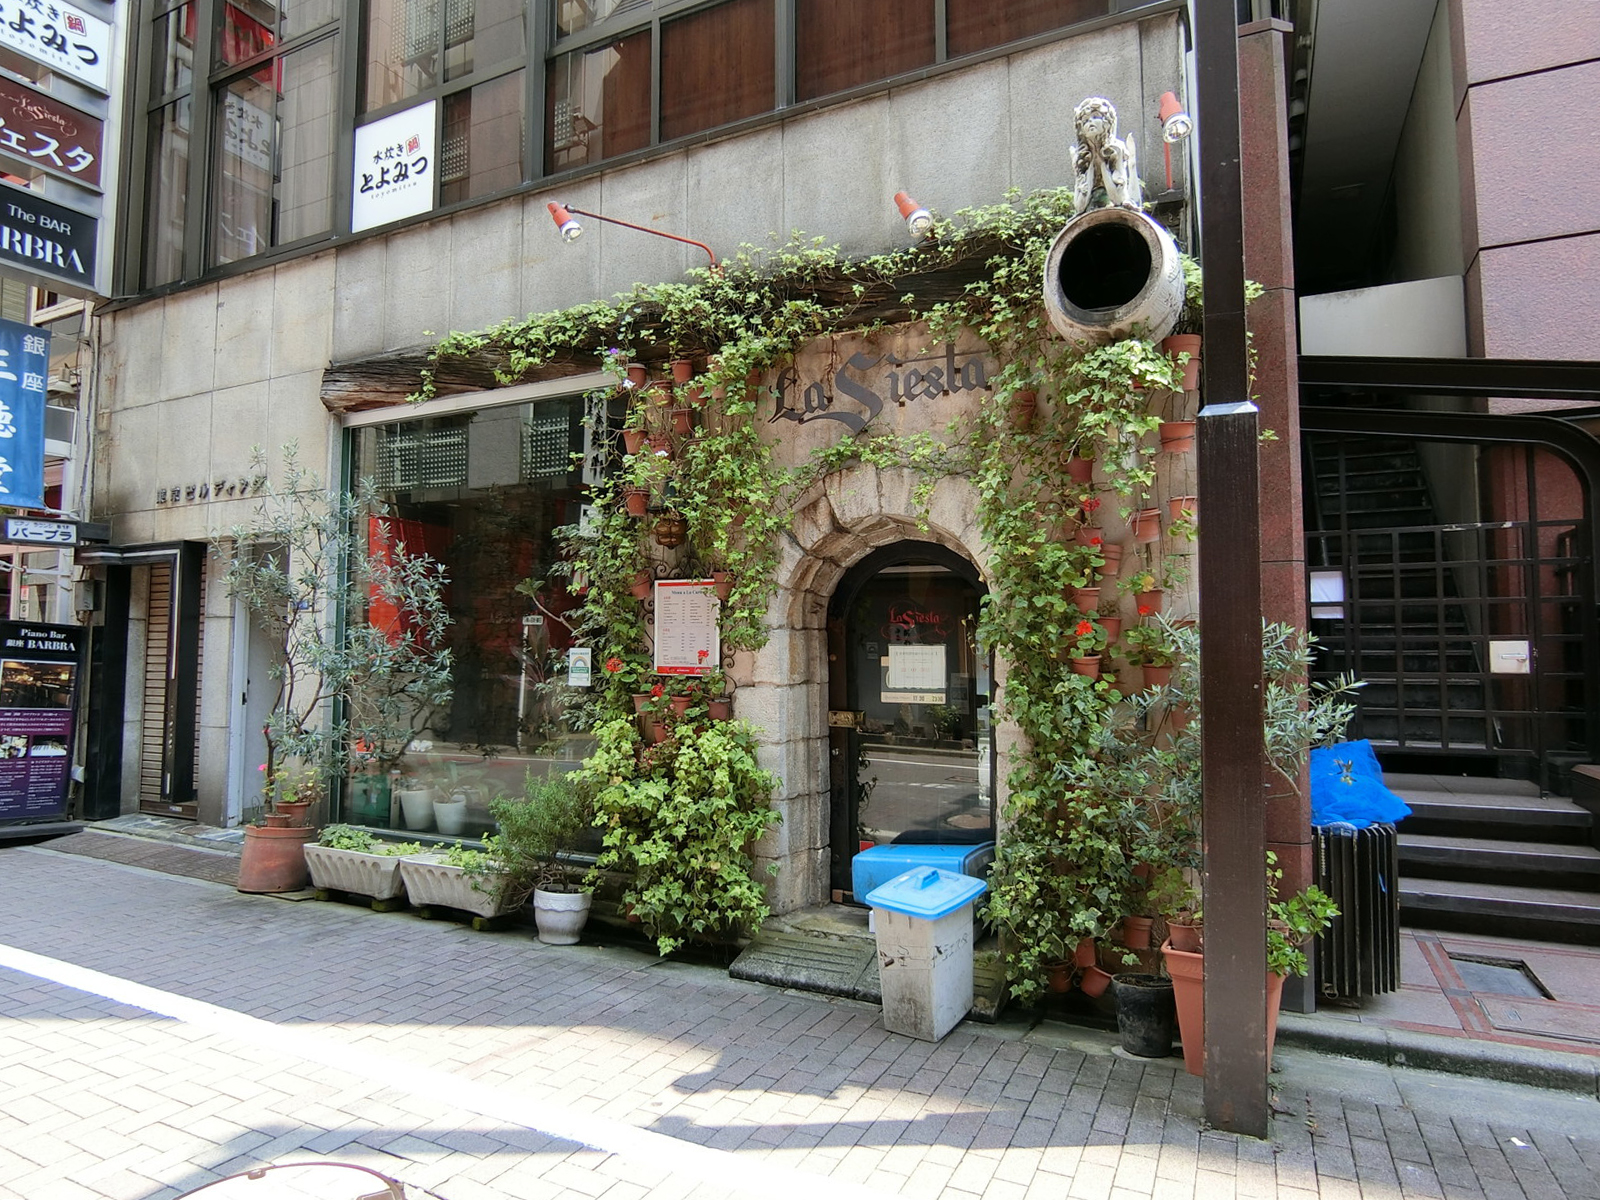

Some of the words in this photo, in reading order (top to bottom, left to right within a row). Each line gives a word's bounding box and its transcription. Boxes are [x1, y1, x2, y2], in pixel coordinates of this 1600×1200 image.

[22, 0, 60, 22] 炊き
[0, 4, 99, 65] よみつ
[373, 143, 404, 165] 水炊き
[360, 156, 428, 194] とよみつ
[7, 203, 36, 223] The
[39, 215, 72, 236] BAR
[0, 225, 85, 274] RBRA
[22, 334, 46, 393] 銀座
[768, 366, 831, 424] La
[800, 344, 991, 434] Siesta
[21, 628, 48, 638] Piano
[49, 630, 67, 639] Bar
[900, 610, 940, 629] Siesta
[27, 640, 76, 651] BARBRA
